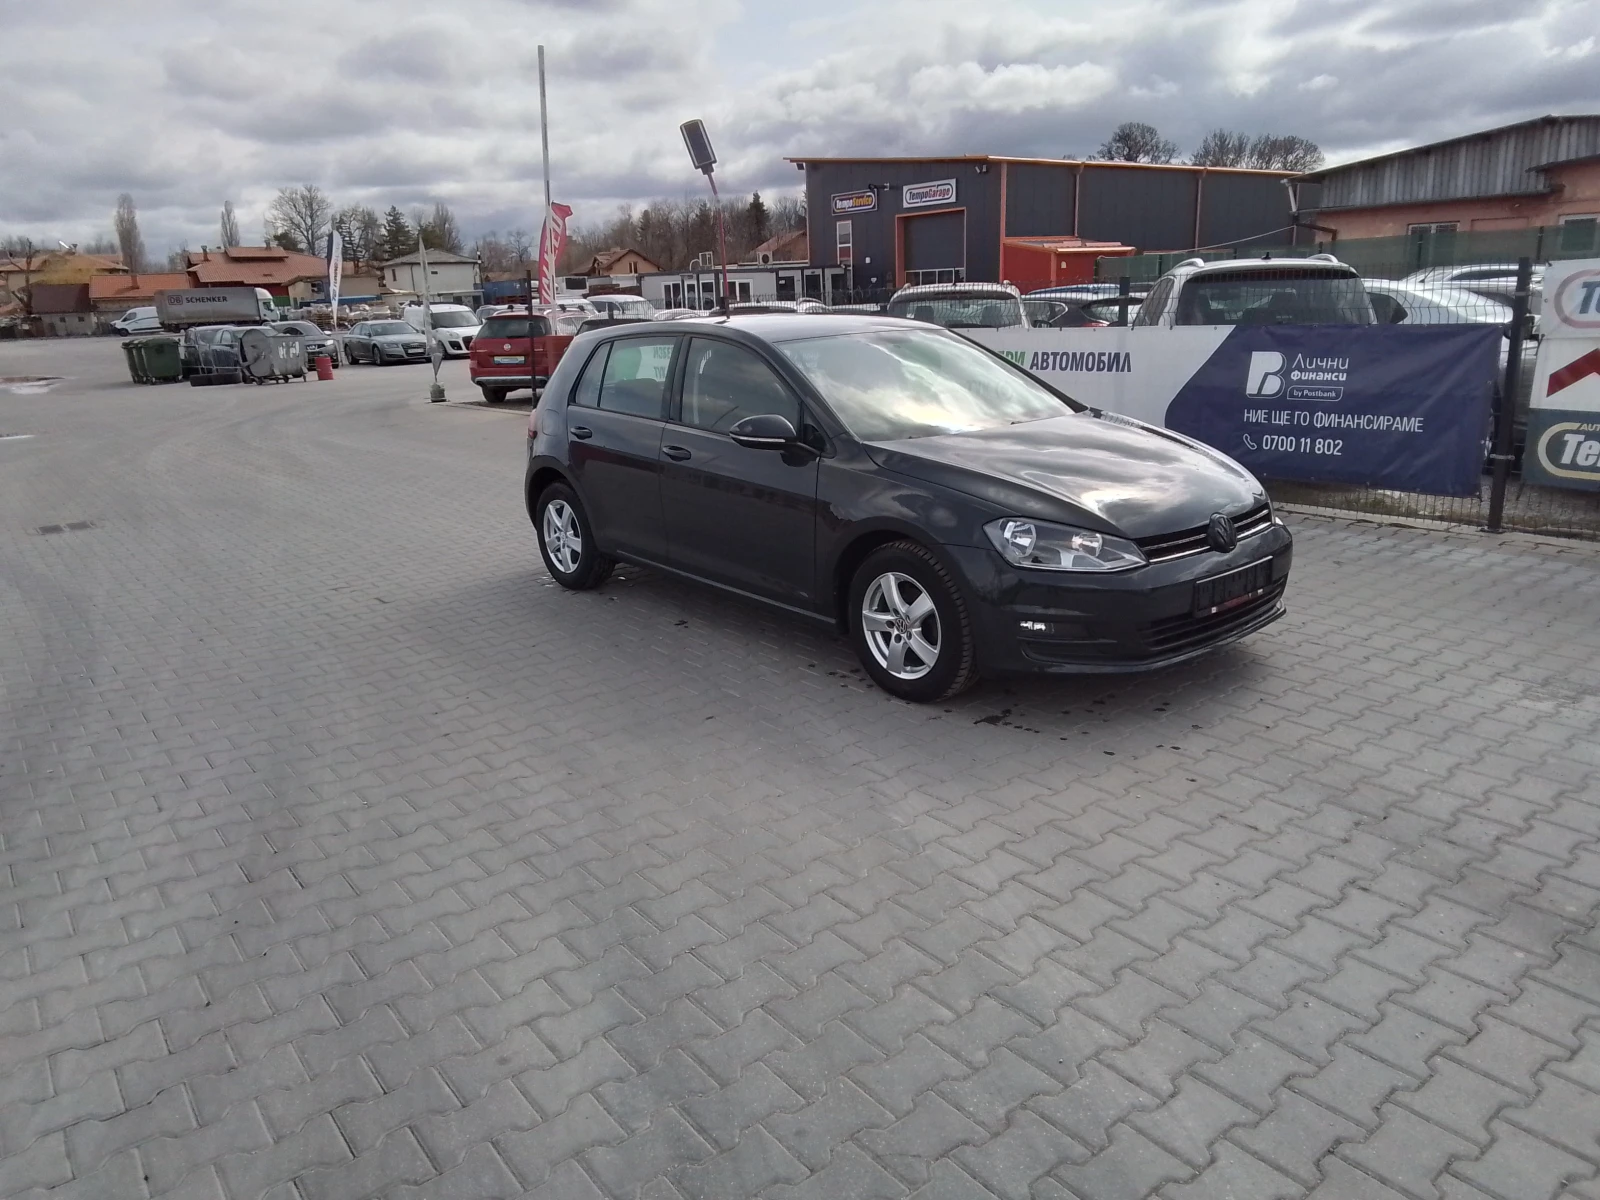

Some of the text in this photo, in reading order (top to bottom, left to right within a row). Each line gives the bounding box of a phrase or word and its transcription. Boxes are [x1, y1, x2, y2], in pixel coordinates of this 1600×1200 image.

[908, 186, 951, 203] TempoGarage
[186, 296, 228, 304] SCHENKER
[1029, 351, 1132, 373] АВТОМОБИЛ
[1292, 353, 1350, 370] Лични
[1293, 389, 1337, 398] by Postbank
[1243, 409, 1424, 433] НИЕ ЩЕ ГО ФИНАНСИРАМЕ
[1262, 434, 1343, 455] 0700 11 802
